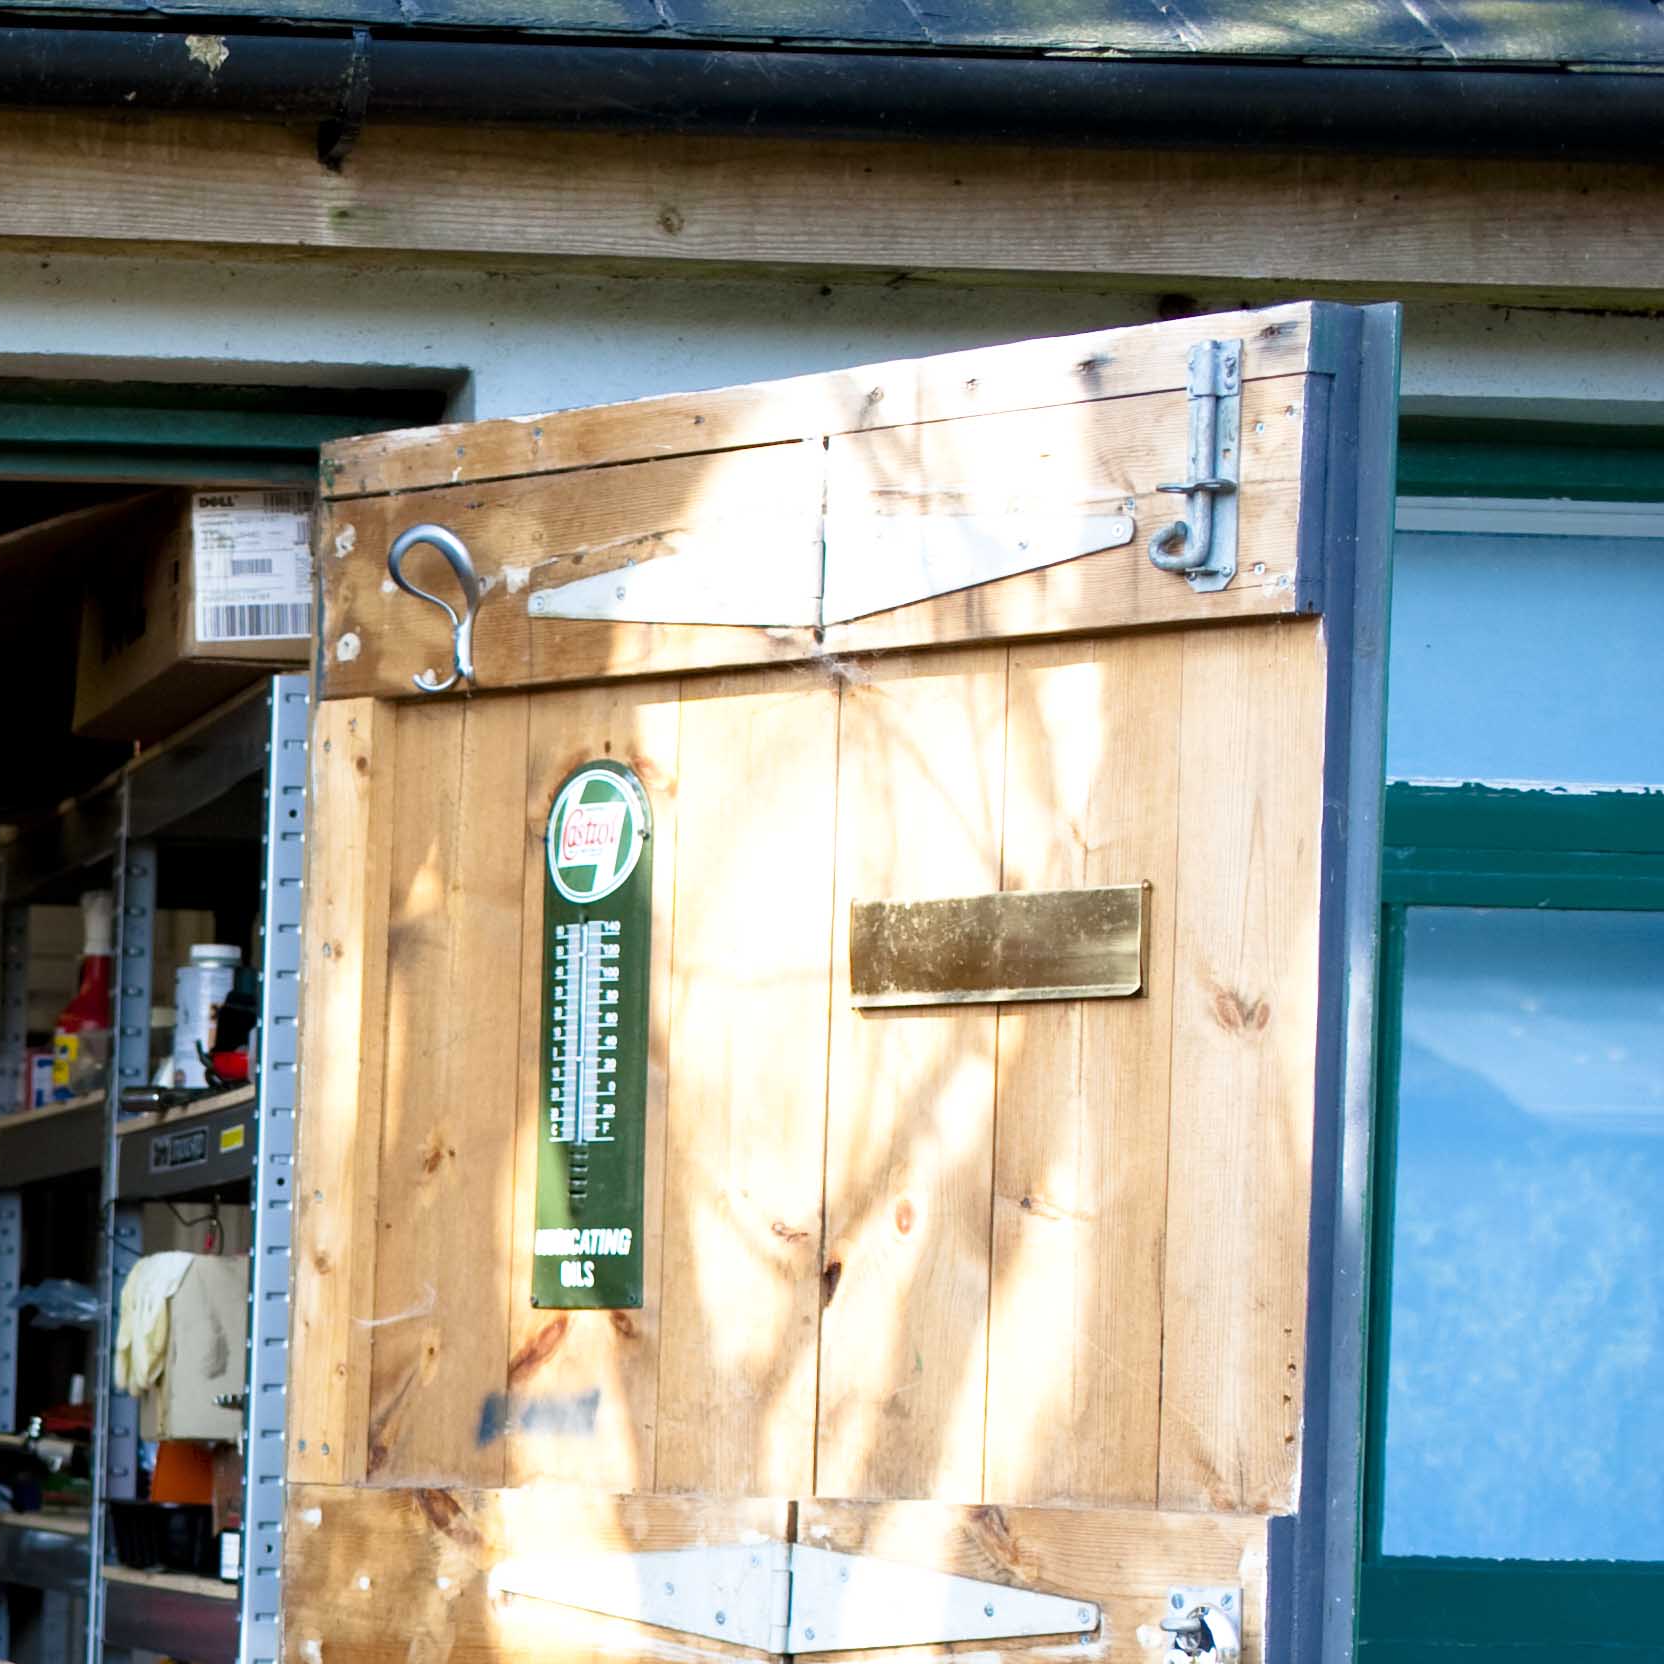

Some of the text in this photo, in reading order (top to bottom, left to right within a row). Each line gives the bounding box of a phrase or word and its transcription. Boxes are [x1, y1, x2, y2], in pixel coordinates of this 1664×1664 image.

[199, 496, 234, 508] DELL
[563, 809, 618, 861] Castrol
[534, 1229, 632, 1255] CATING
[560, 1260, 595, 1287] OILS
